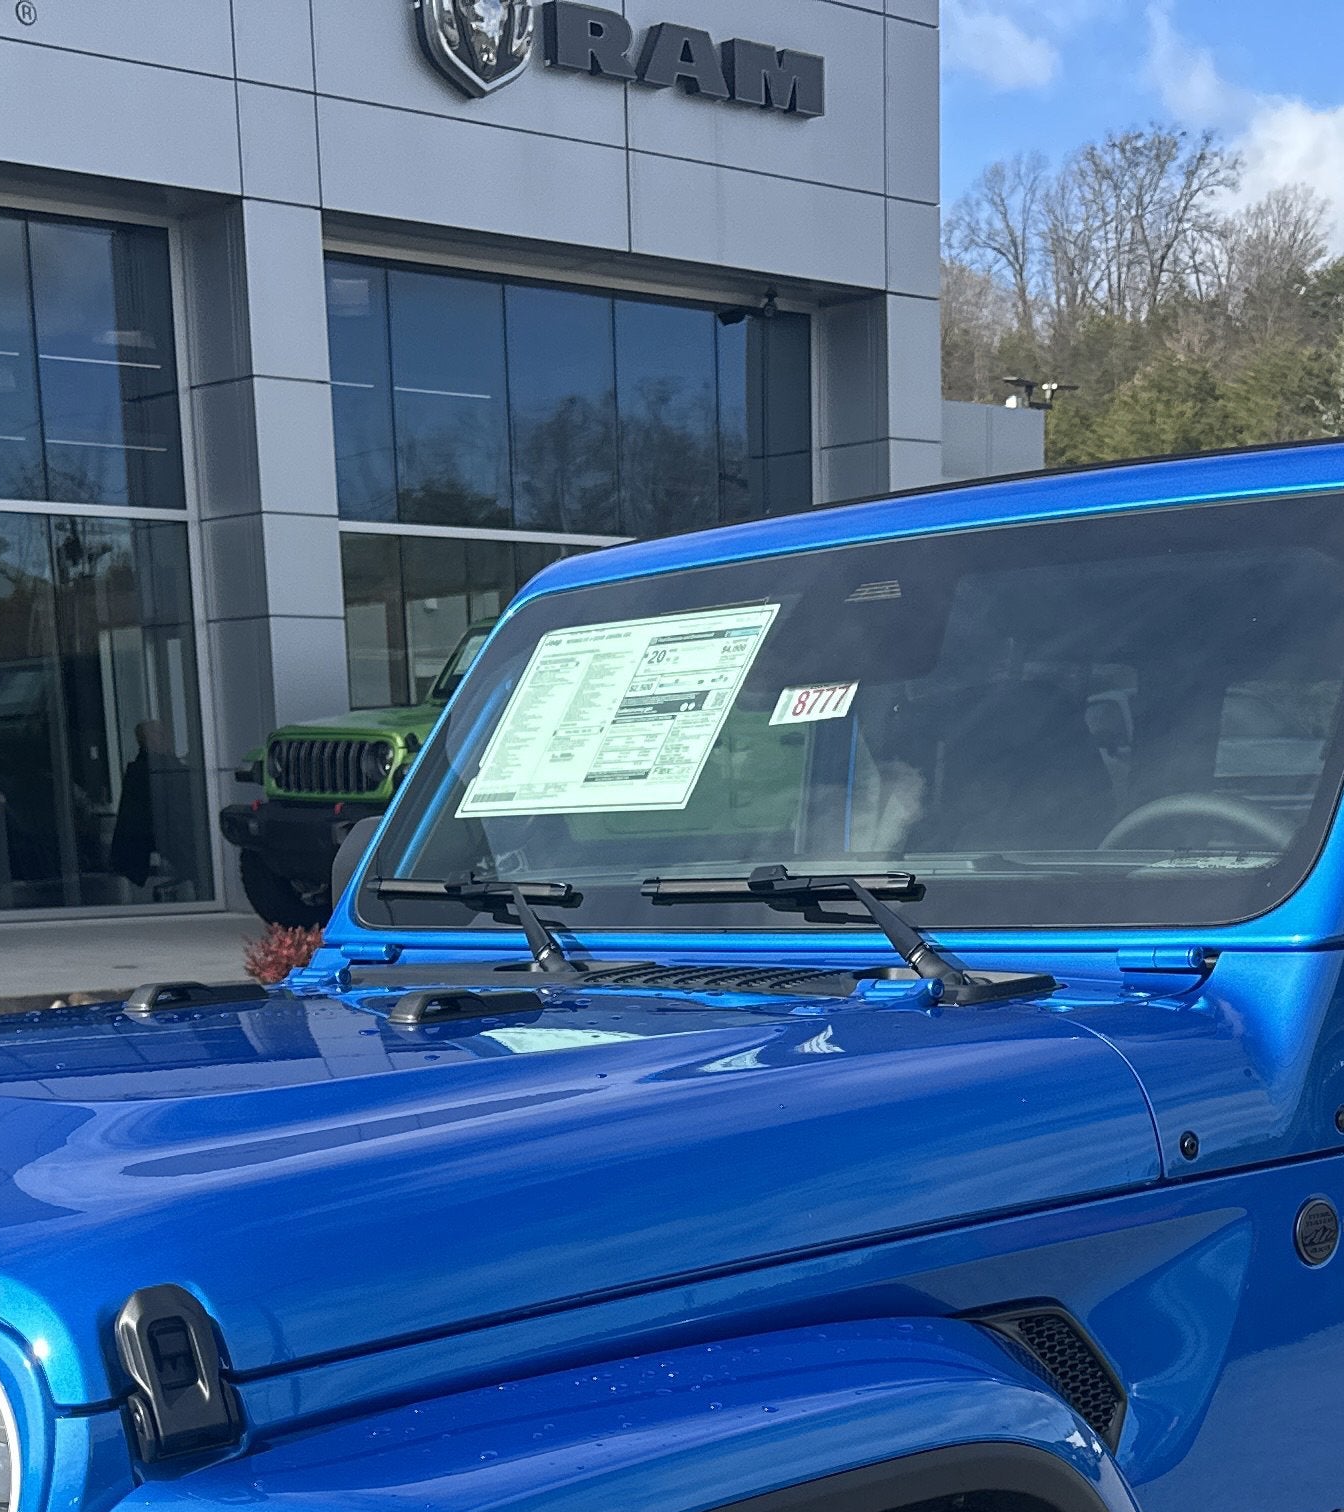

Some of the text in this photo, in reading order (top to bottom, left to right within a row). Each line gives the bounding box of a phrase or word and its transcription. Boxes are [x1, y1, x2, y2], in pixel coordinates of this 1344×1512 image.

[544, 0, 825, 118] RAM
[647, 649, 668, 665] 20
[791, 684, 853, 717] 8777
